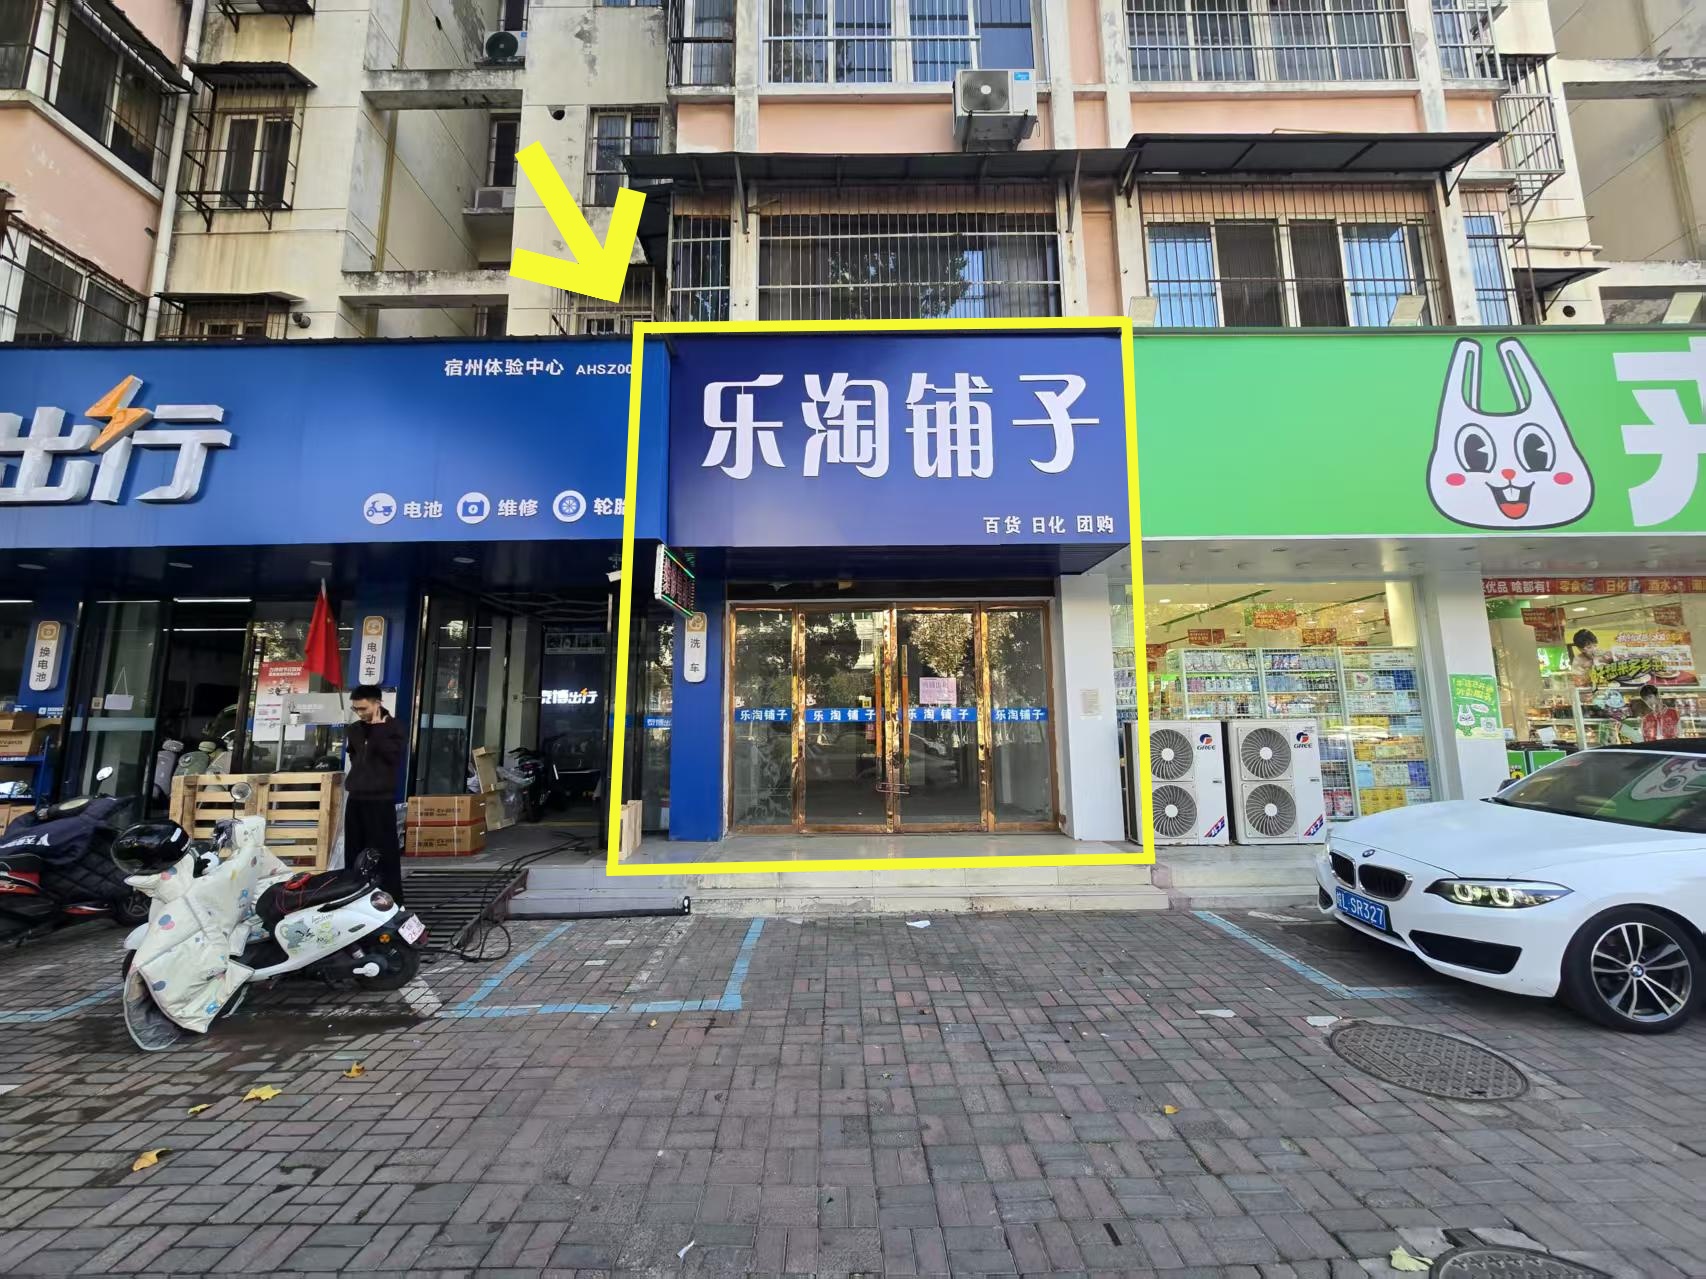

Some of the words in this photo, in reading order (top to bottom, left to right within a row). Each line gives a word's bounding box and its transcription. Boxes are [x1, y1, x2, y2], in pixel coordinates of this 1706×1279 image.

[444, 358, 565, 377] 宿州体验中心
[701, 372, 1100, 480] 乐淘铺子
[0, 375, 233, 504] 出行
[403, 501, 443, 518] 电池
[498, 499, 538, 517] 维修
[983, 516, 1021, 534] 百货
[1032, 515, 1066, 534] 日化
[1076, 515, 1114, 533] 团购
[35, 646, 51, 682] 换电池
[365, 642, 378, 677] 电动车
[690, 637, 701, 673] 洗车
[740, 709, 788, 721] 乐淘铺子
[813, 709, 876, 721] 乐淘铺子
[908, 708, 969, 720] 乐淘铺子
[995, 708, 1045, 721] 乐淘铺子
